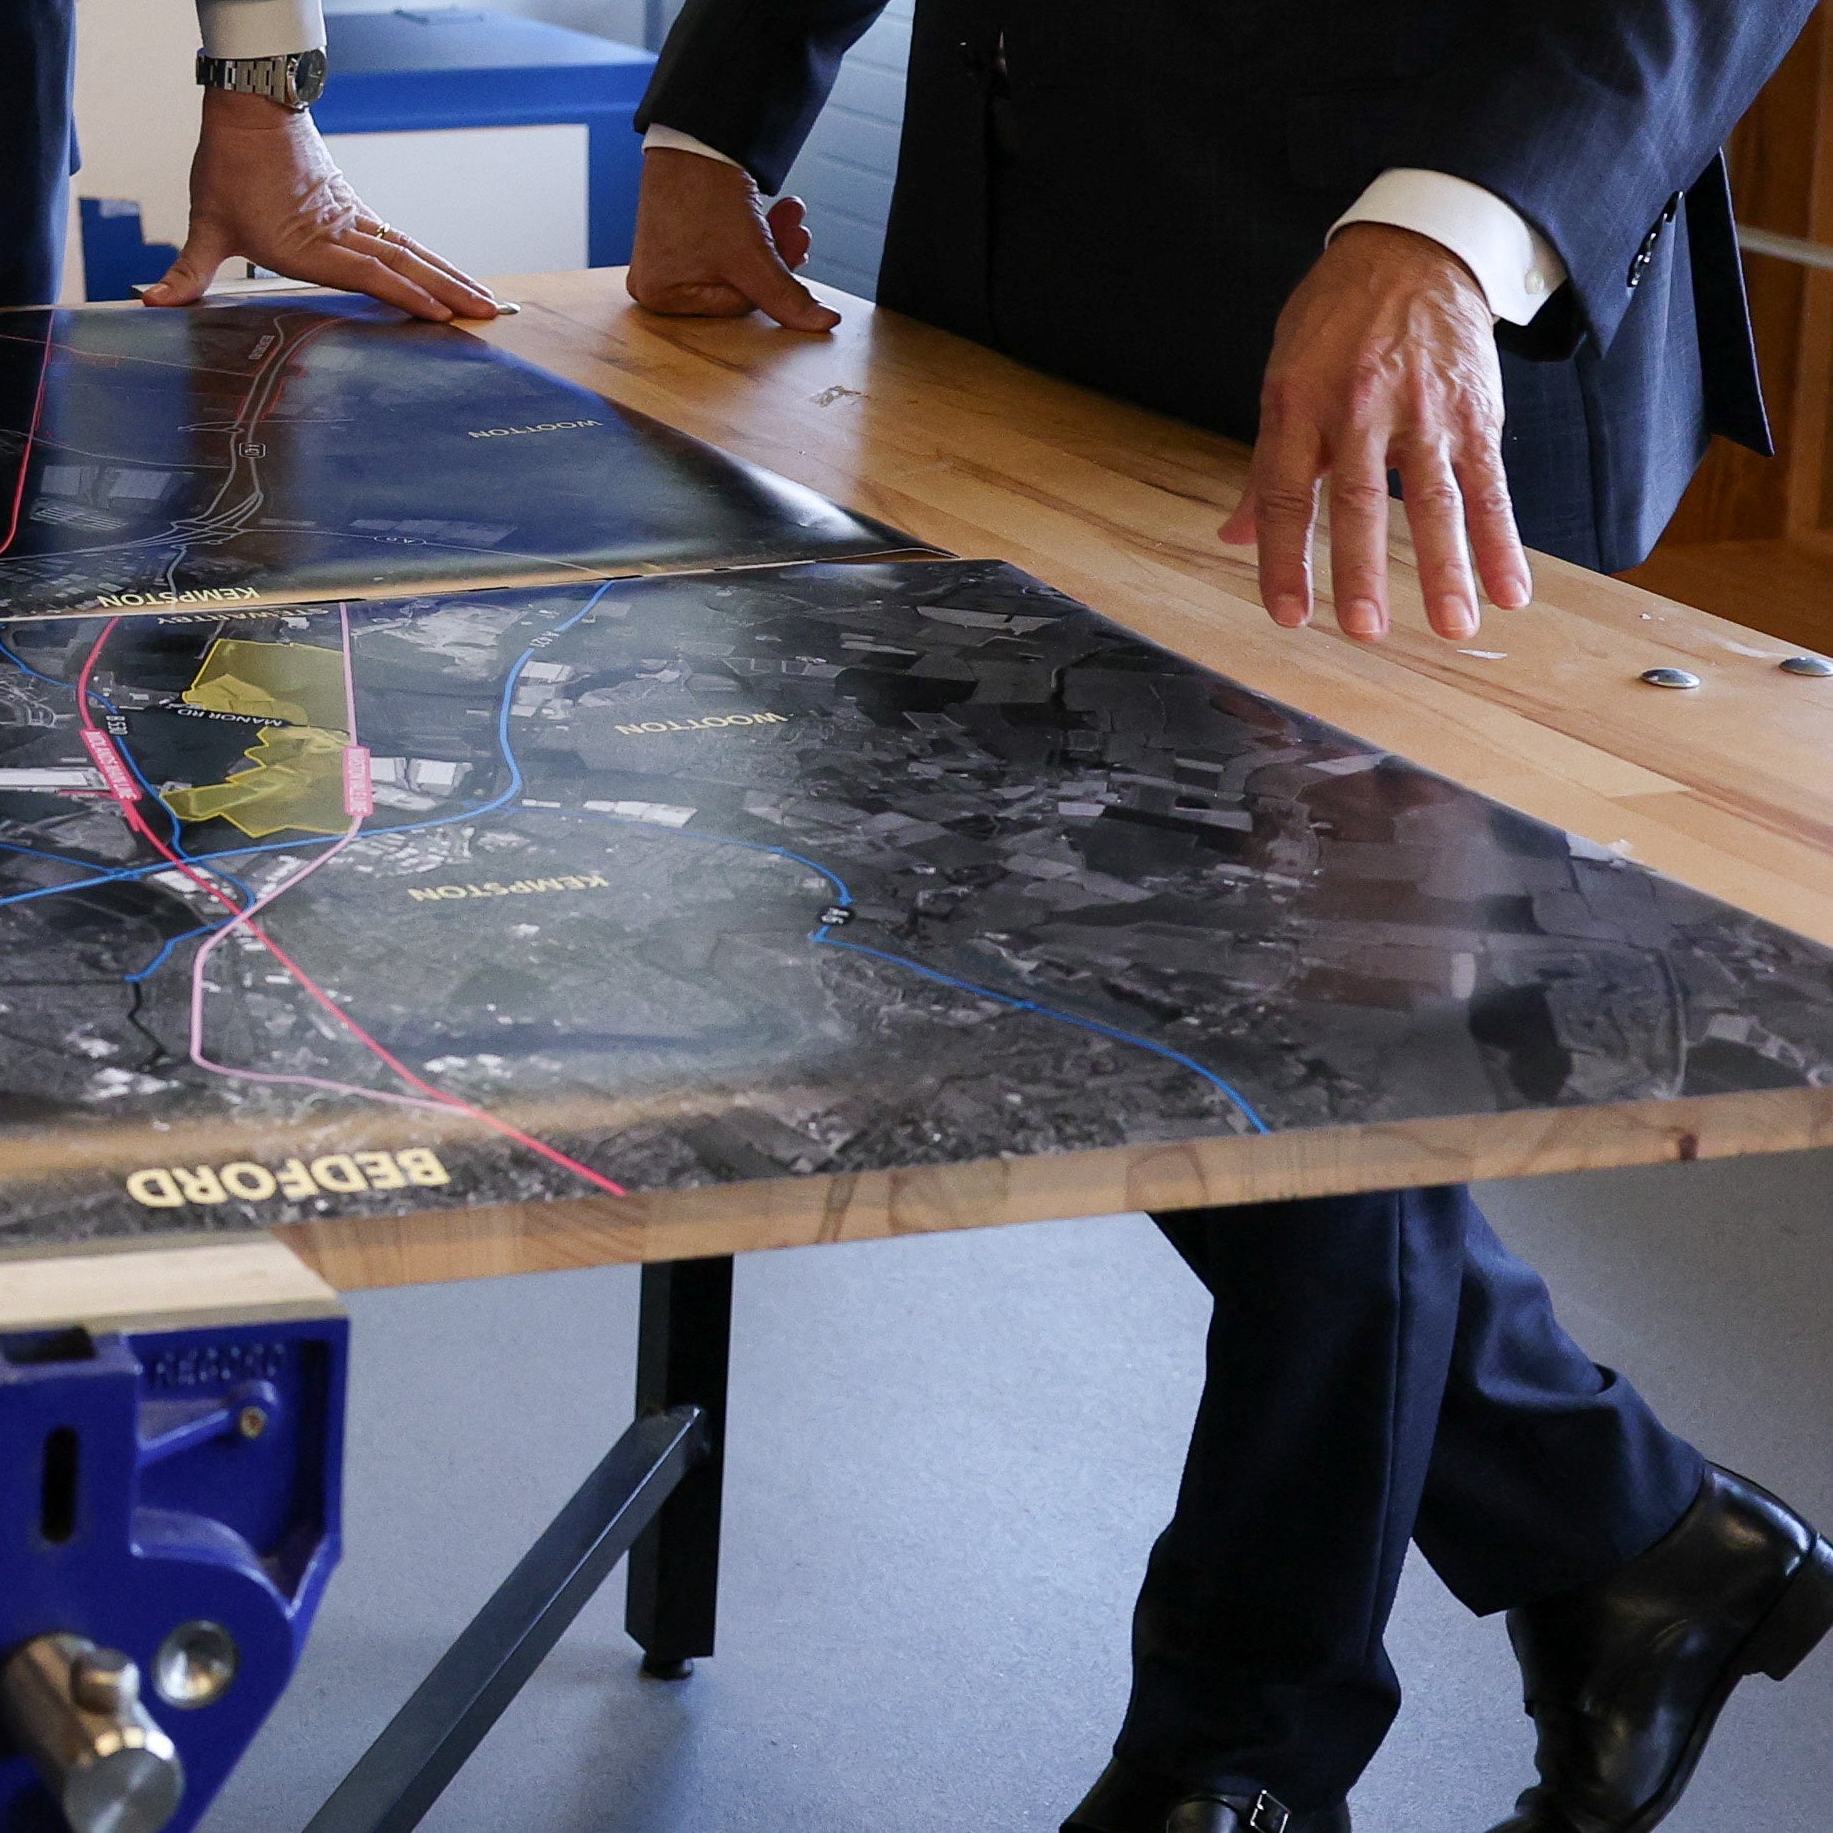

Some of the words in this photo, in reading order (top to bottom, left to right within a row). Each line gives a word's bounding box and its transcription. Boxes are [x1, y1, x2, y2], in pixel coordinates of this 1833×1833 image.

[467, 419, 604, 439] WOOTTON
[97, 587, 260, 608] KEMPSTON
[157, 608, 329, 625] STEWARTBY
[176, 708, 205, 718] RD
[207, 712, 282, 727] MANOR
[614, 712, 789, 735] WOOTTON
[407, 875, 610, 902] KEMPSTON
[125, 1147, 452, 1209] BEDFORD
